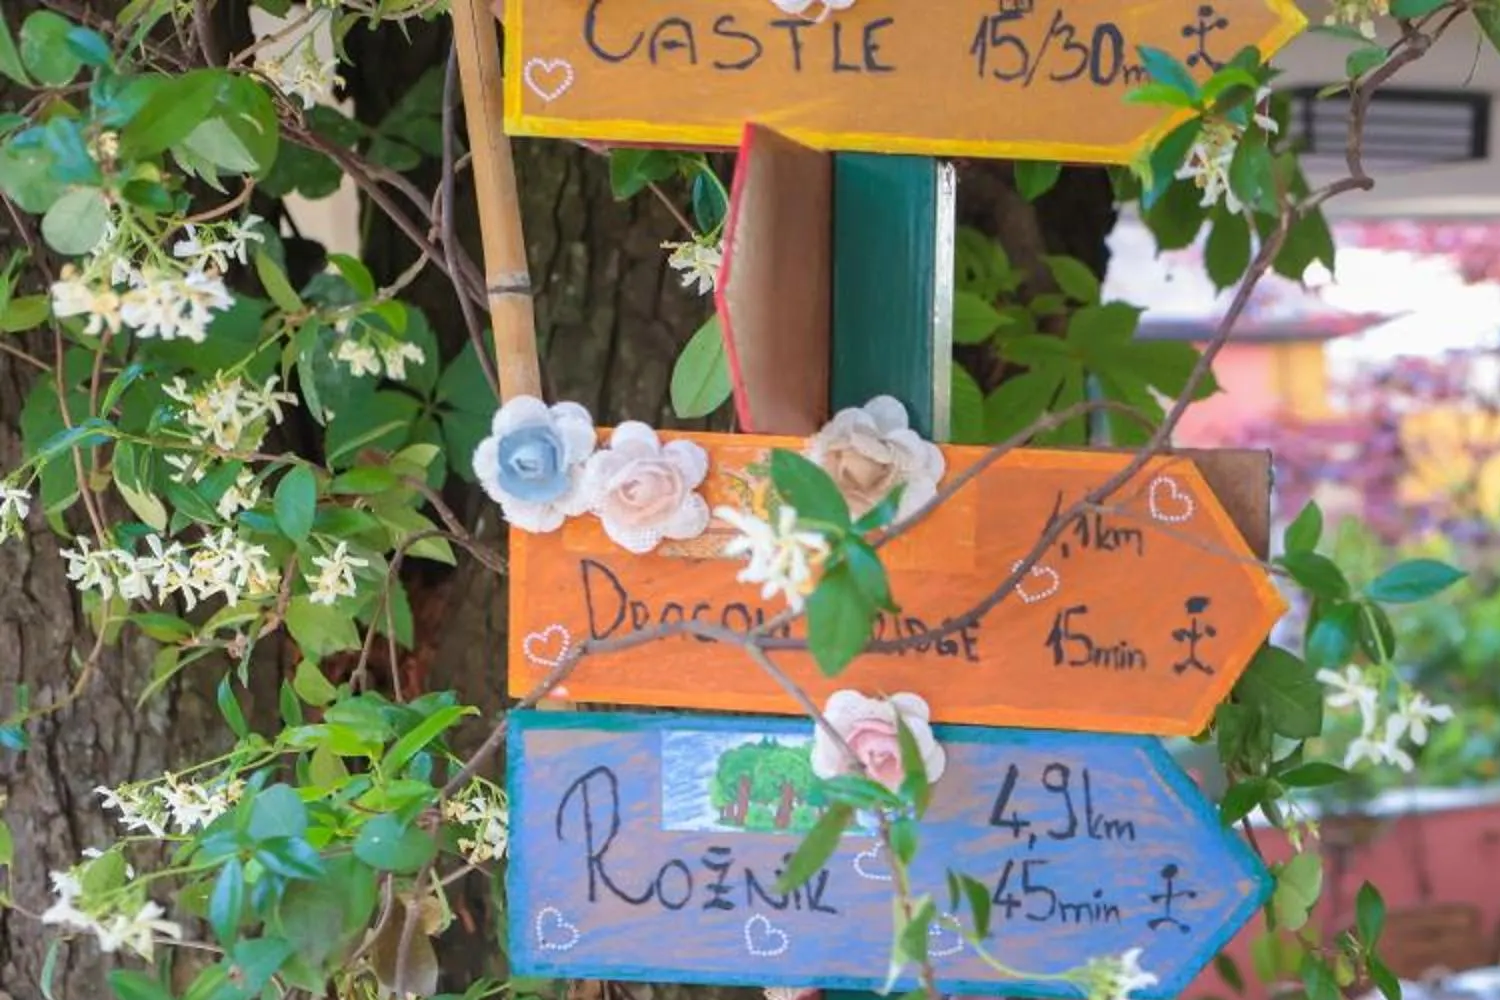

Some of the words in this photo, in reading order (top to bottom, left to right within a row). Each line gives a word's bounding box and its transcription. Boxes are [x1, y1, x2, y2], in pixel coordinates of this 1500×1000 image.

[584, 0, 896, 72] CASTLE
[968, 8, 1150, 89] 15/30m
[1044, 604, 1148, 672] 15min
[989, 762, 1137, 850] 4,9km
[991, 857, 1123, 927] 45min
